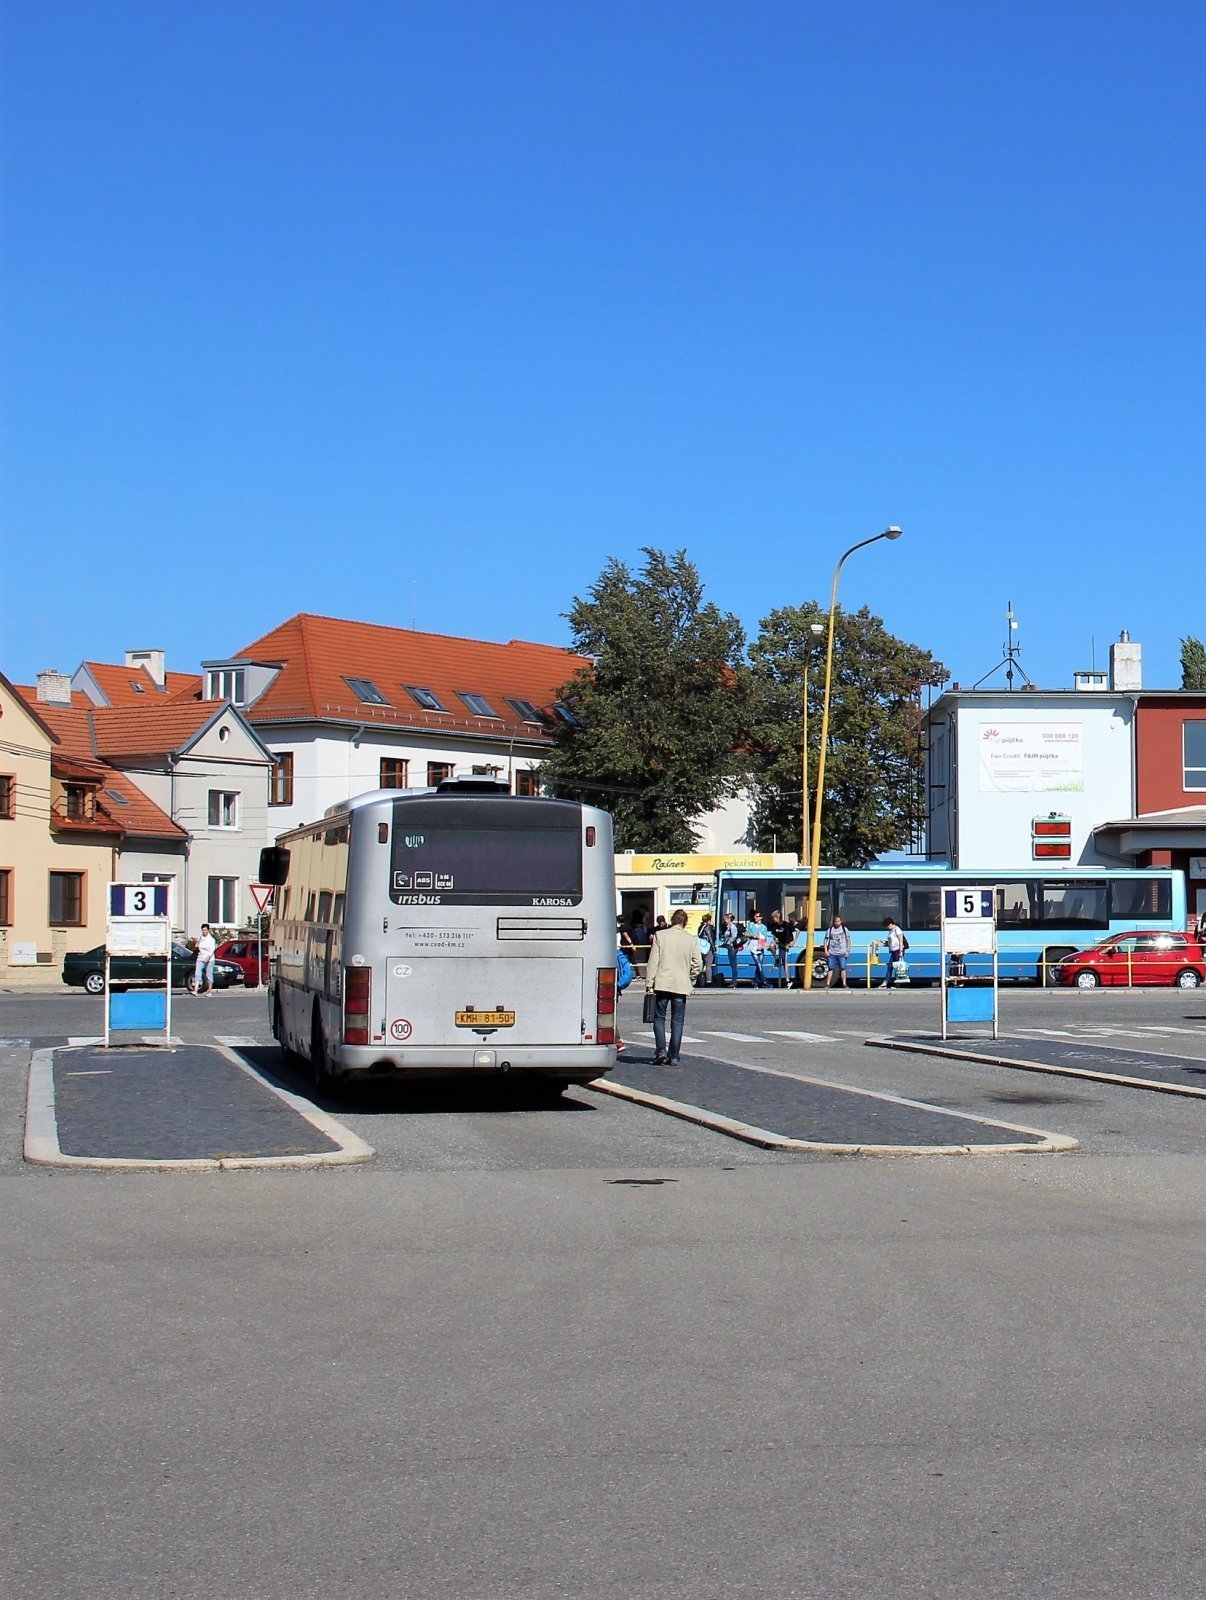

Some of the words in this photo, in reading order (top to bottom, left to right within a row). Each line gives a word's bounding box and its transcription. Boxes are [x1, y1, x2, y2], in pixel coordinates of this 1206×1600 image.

[652, 858, 686, 870] Rašner
[724, 859, 762, 869] pekařství
[134, 891, 146, 911] 3
[398, 894, 441, 904] irisbus
[964, 895, 974, 913] 5
[395, 967, 410, 976] CZ
[461, 1014, 478, 1023] KMH
[394, 1024, 408, 1034] 100
